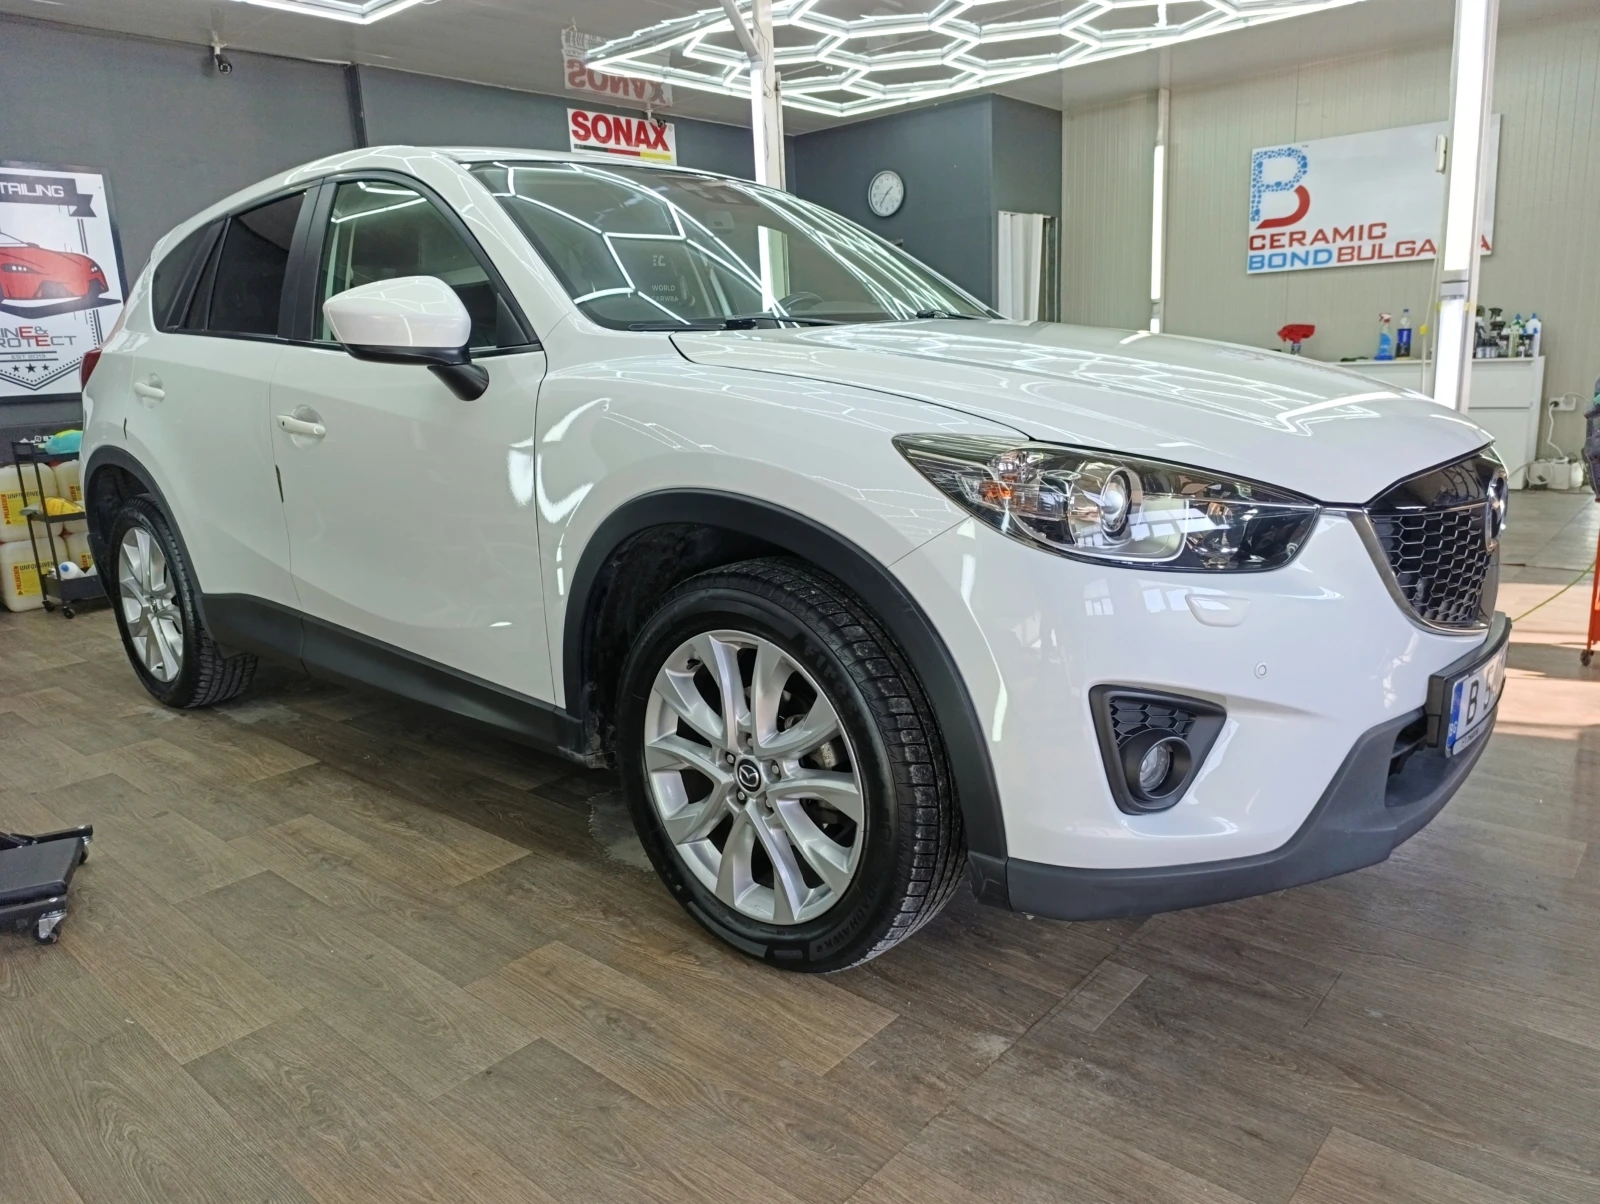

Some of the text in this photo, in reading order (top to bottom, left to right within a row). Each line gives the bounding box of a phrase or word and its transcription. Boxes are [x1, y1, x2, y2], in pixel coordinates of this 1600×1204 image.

[571, 110, 670, 151] SONAX
[1249, 222, 1387, 251] CERAMIC
[651, 284, 676, 292] WORLD
